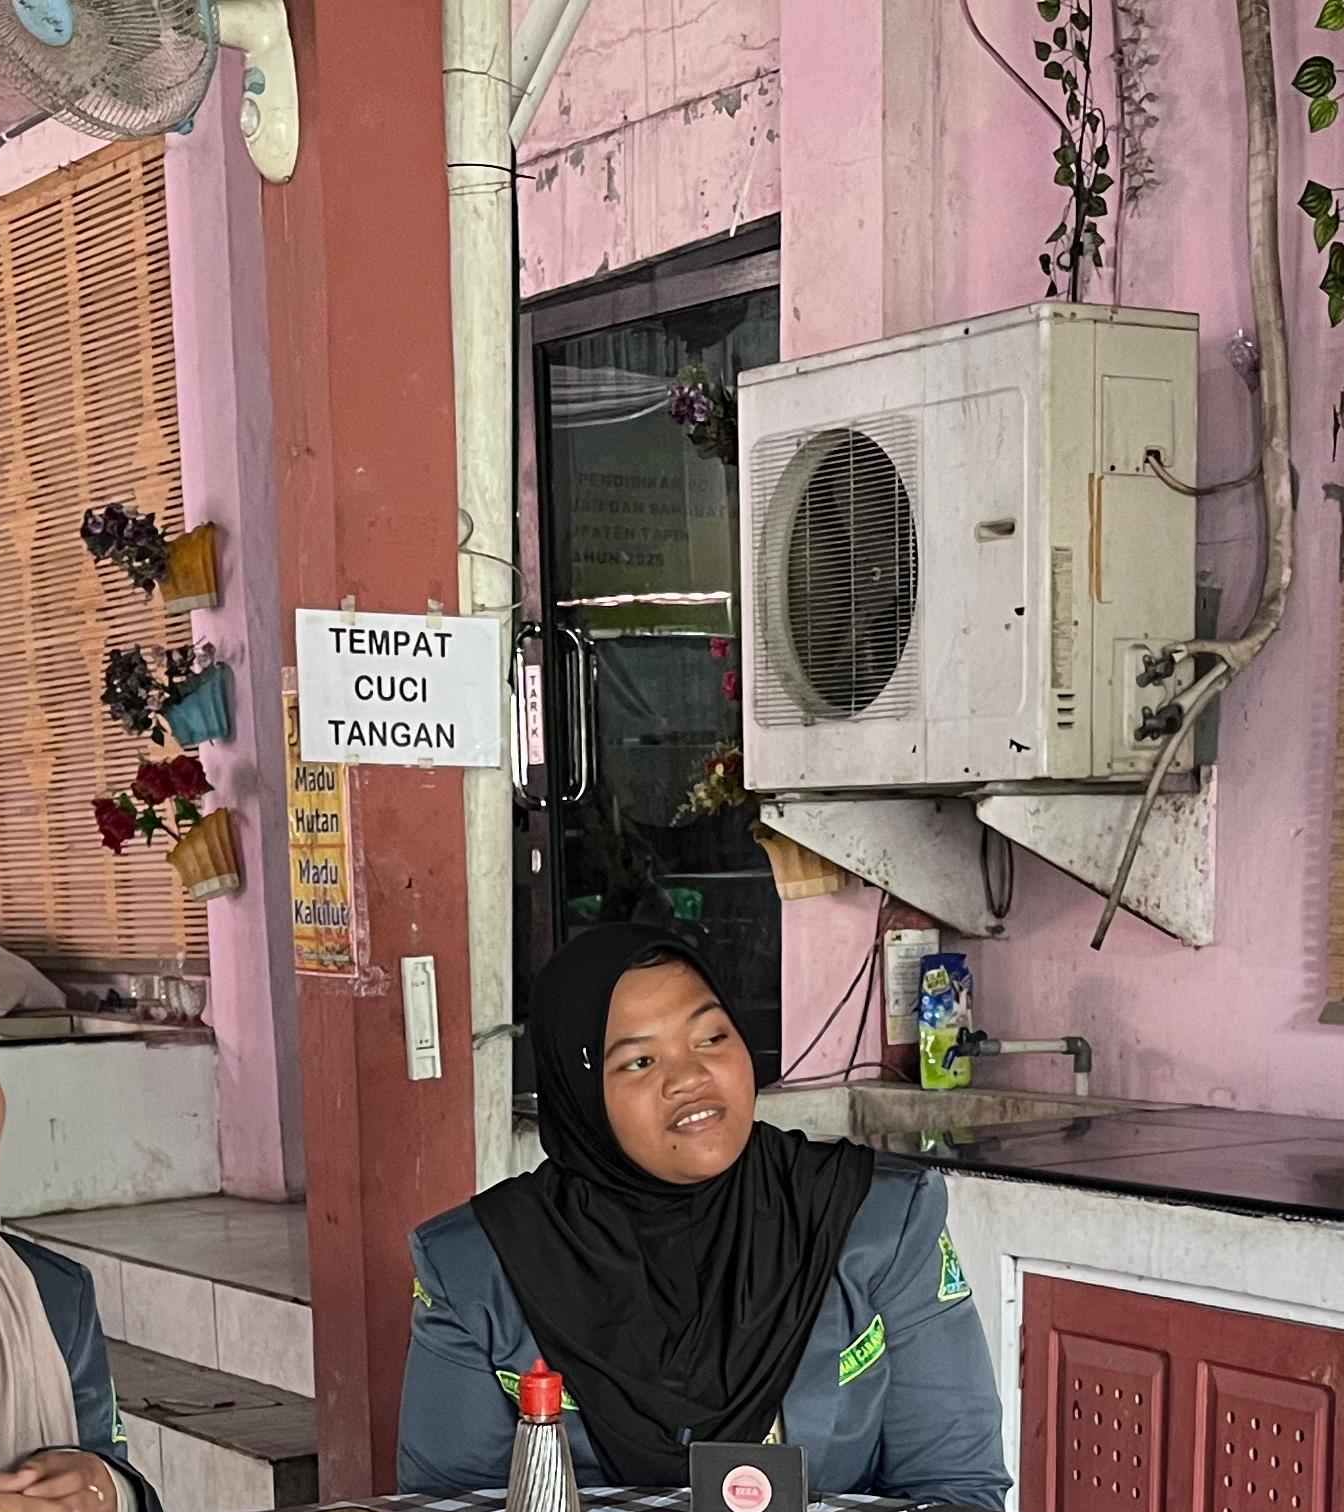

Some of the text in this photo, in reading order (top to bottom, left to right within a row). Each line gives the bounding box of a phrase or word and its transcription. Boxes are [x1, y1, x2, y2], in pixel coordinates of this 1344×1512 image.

[329, 628, 452, 658] TEMPAT
[354, 676, 428, 703] CUCI
[529, 675, 539, 737] TARIK
[328, 720, 456, 749] TANGAN
[295, 767, 335, 792] Madu
[295, 808, 339, 834] Hutan
[299, 860, 338, 885] Madu
